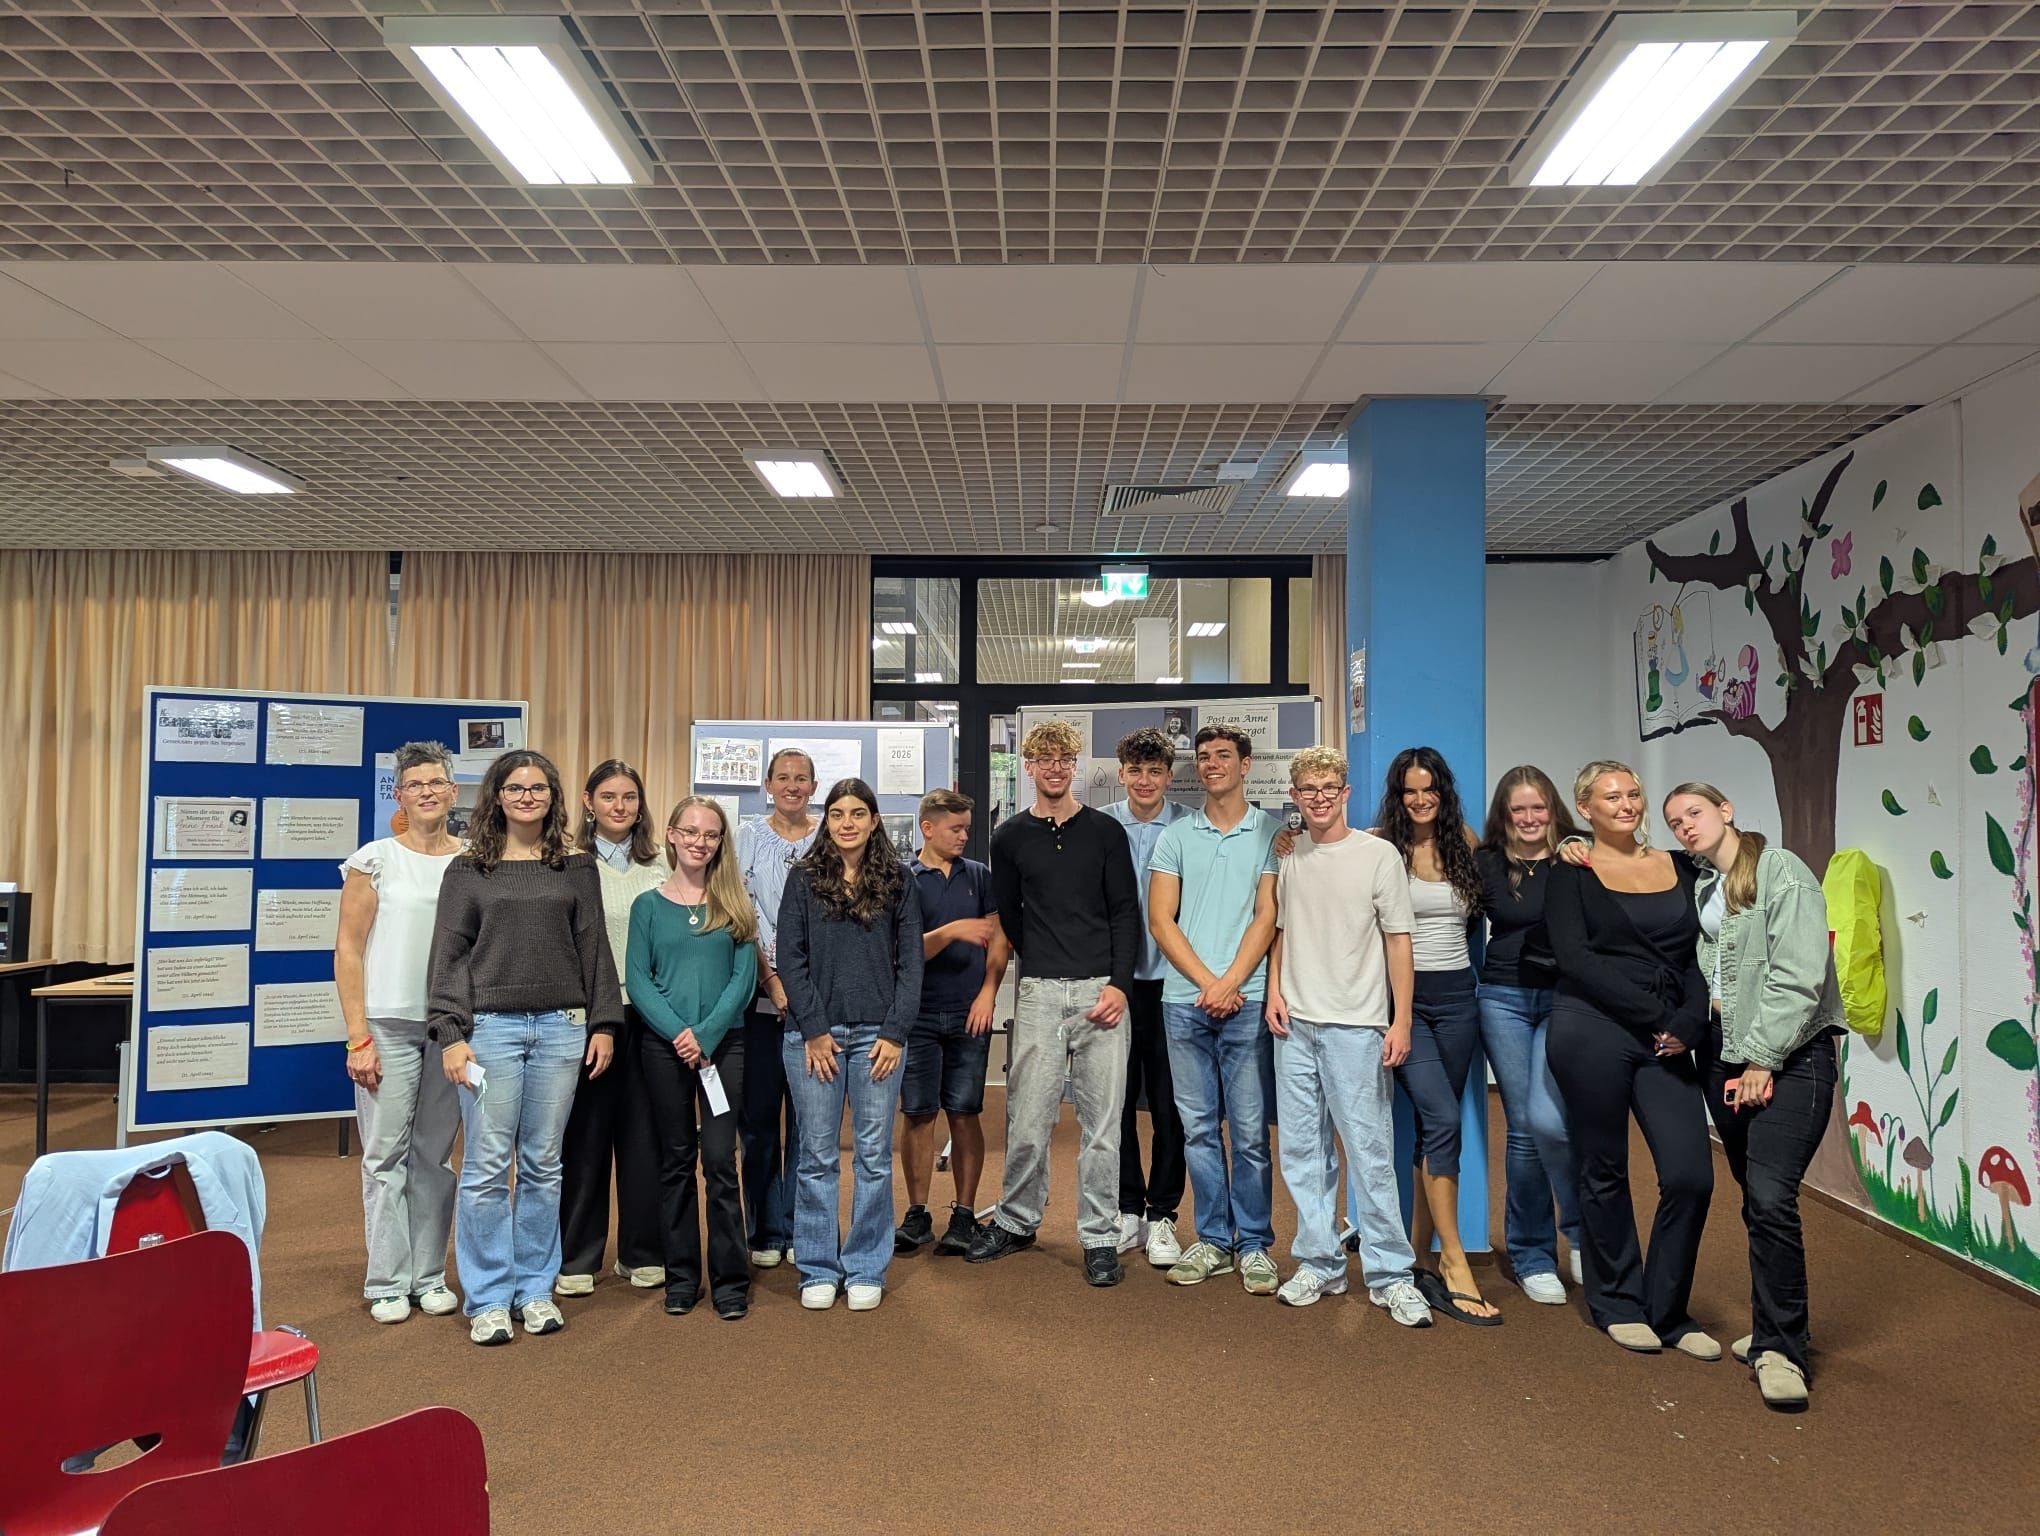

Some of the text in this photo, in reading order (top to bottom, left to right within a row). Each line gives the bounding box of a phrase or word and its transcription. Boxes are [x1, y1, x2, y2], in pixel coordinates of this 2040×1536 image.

[1206, 715, 1225, 724] Post
[1242, 714, 1268, 723] Anne
[1242, 727, 1266, 738] rgot
[892, 750, 912, 759] 2026
[1246, 788, 1256, 796] für
